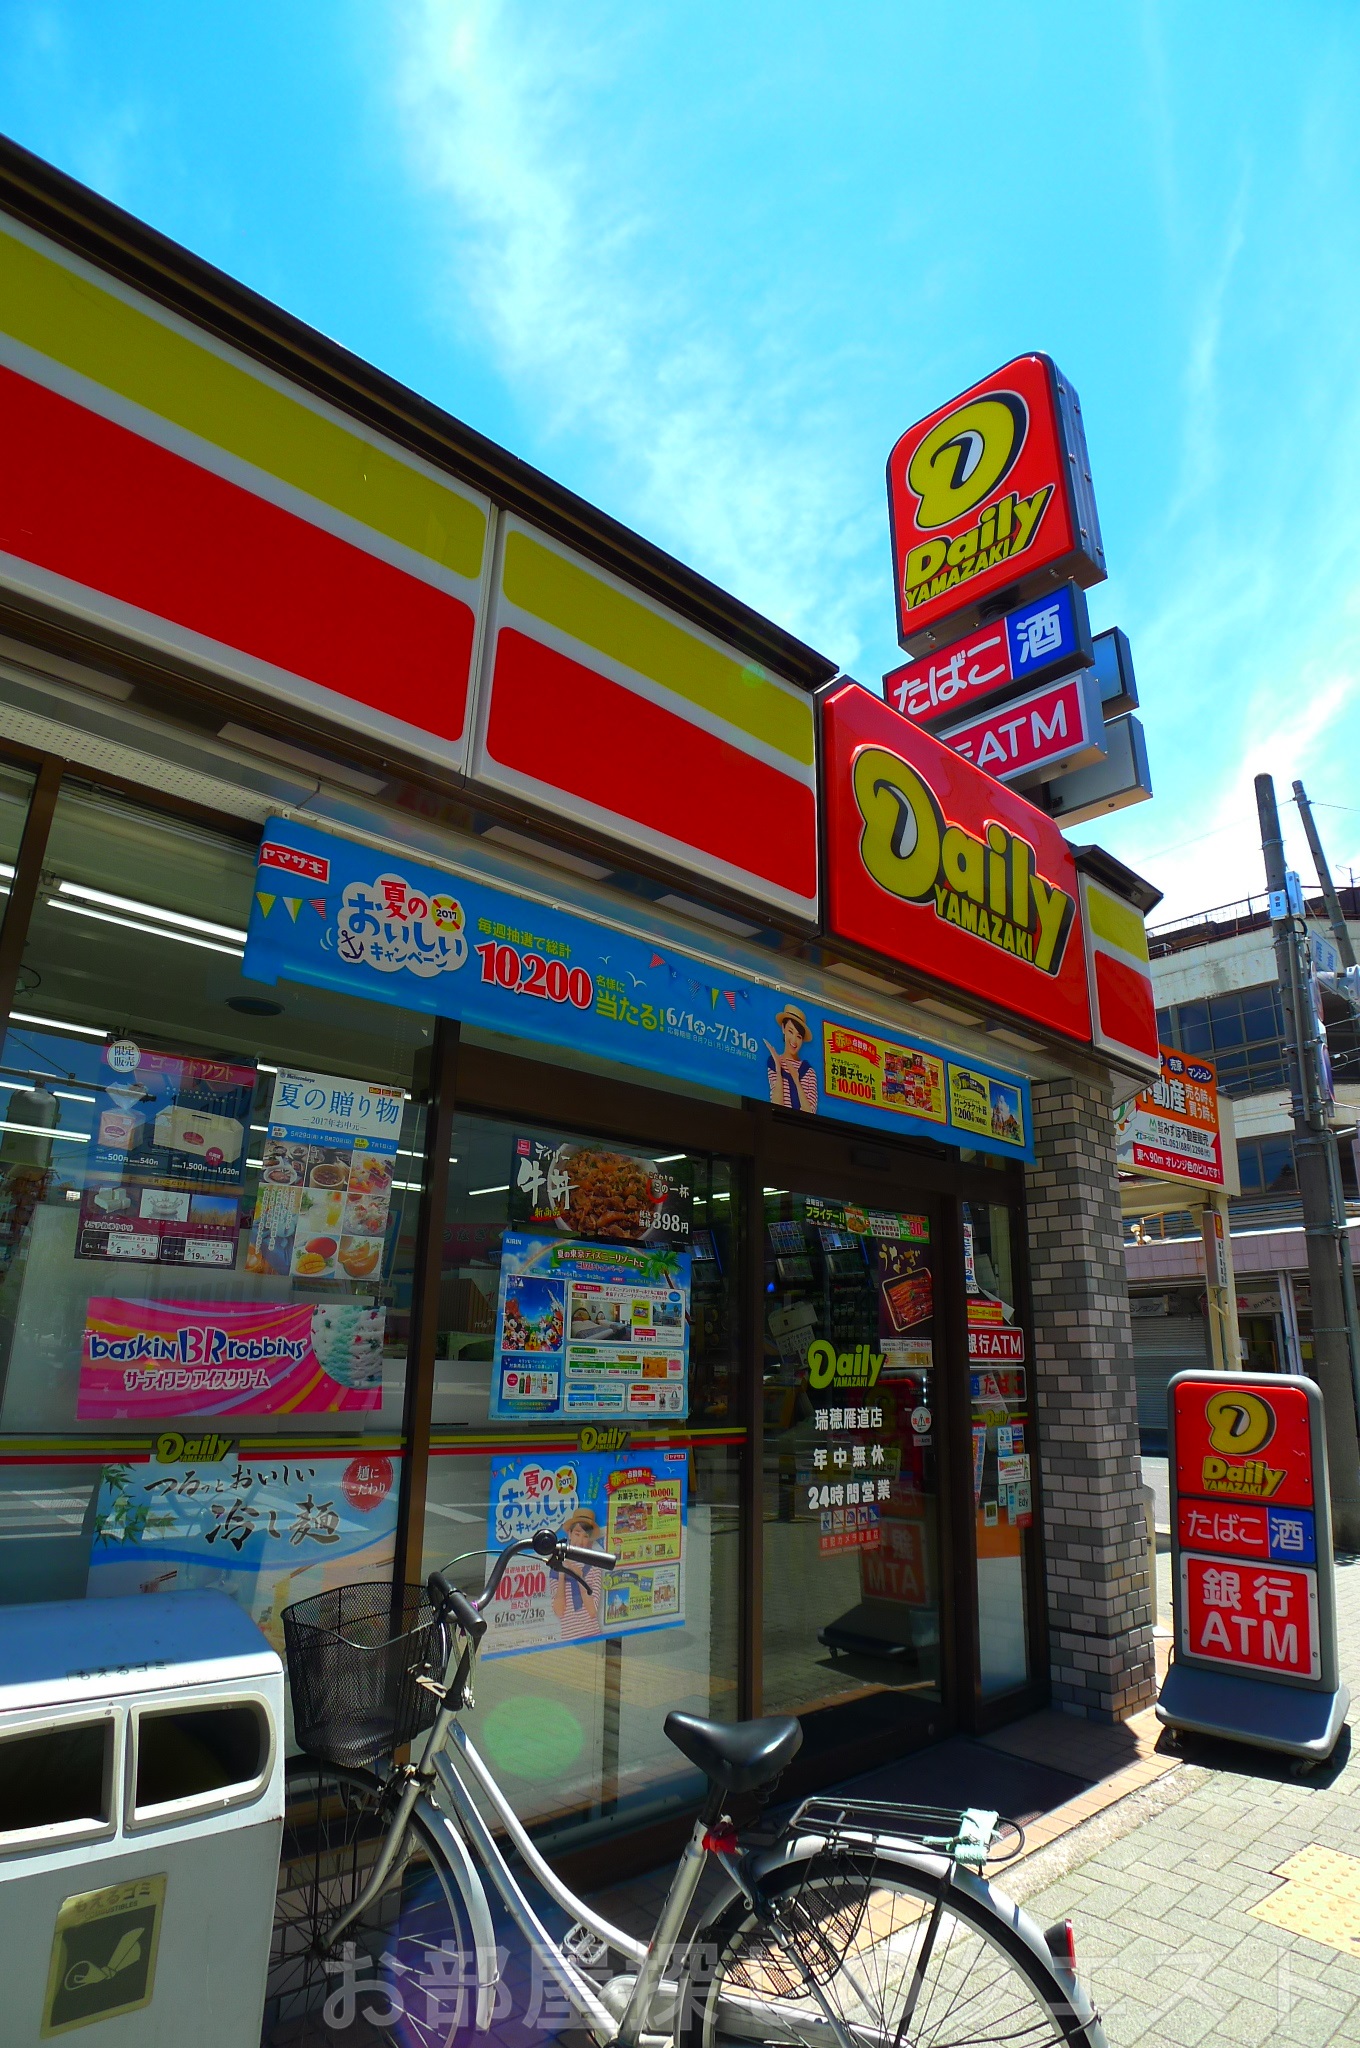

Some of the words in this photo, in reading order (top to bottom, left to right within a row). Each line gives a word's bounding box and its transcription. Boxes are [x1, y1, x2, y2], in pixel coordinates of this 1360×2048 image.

[904, 482, 1055, 588] Daily
[906, 537, 1012, 611] YAMAZAKI
[893, 634, 1006, 715] たばこ
[1017, 604, 1063, 664] 酒
[960, 699, 1068, 768] ATM
[261, 847, 323, 875] ヤマザキ
[852, 745, 1075, 977] Daily
[381, 880, 427, 921] 夏の
[348, 892, 462, 958] おいしい
[436, 909, 457, 920] 2017
[934, 884, 1035, 963] YAMAZAKI
[478, 917, 572, 959] 毎週抽選で総計
[370, 942, 448, 968] キャンペーン
[474, 940, 593, 1009] 10,200
[596, 974, 625, 993] 名様に
[113, 1045, 135, 1056] 限定
[113, 1056, 136, 1067] 販売
[150, 1056, 233, 1081] ゴールドソフト
[831, 1064, 875, 1084] お菓子セット
[1187, 1067, 1212, 1081] マンション
[837, 1078, 872, 1099] 10,000
[1185, 1083, 1214, 1107] 売る時も
[276, 1080, 400, 1125] 夏の贈り物
[1188, 1100, 1216, 1124] 買う時も
[534, 1141, 571, 1163] デイリー
[516, 1157, 580, 1210] 牛丼
[654, 1181, 690, 1199] この一杯
[534, 1207, 560, 1218] 新商品
[652, 1211, 690, 1235] 398円
[909, 1220, 923, 1236] 30
[505, 1237, 522, 1246] KIRIN
[1253, 1295, 1275, 1309] BOOKS
[90, 1335, 178, 1362] baskin
[178, 1327, 227, 1365] BR
[807, 1339, 886, 1389] Daily
[833, 1377, 868, 1388] YAMAZAKI
[984, 1374, 1025, 1396] たばこ
[814, 1406, 883, 1431] 瑞穂雁道店
[156, 1432, 235, 1463] Daily
[580, 1426, 628, 1452] Daily
[180, 1454, 214, 1463] YAMAZAKI
[813, 1444, 885, 1471] 年中無休
[356, 1466, 379, 1480] 麺に
[524, 1469, 554, 1500] 夏の
[558, 1476, 572, 1487] 2017
[1202, 1455, 1289, 1497] Daily
[349, 1482, 386, 1497] こだわり
[618, 1492, 647, 1501] お菓子セット
[650, 1488, 671, 1498] 10,000
[808, 1478, 891, 1510] 24時間営業
[1203, 1479, 1264, 1496] YAMAZAKI
[502, 1487, 575, 1520] おいしい
[1018, 1498, 1029, 1508] Edy
[204, 1494, 340, 1551] 冷し麺
[515, 1513, 566, 1535] キャンペーン
[1187, 1510, 1264, 1546] たばこ
[1270, 1516, 1304, 1553] 酒
[495, 1571, 546, 1601] 10,200
[1202, 1567, 1294, 1618] 銀行
[1200, 1611, 1299, 1665] ATM
[77, 1660, 167, 1681] もえるゴミ
[74, 1881, 151, 1913] もえるゴミ
[84, 1900, 138, 1920] COMBUSTIBLES
